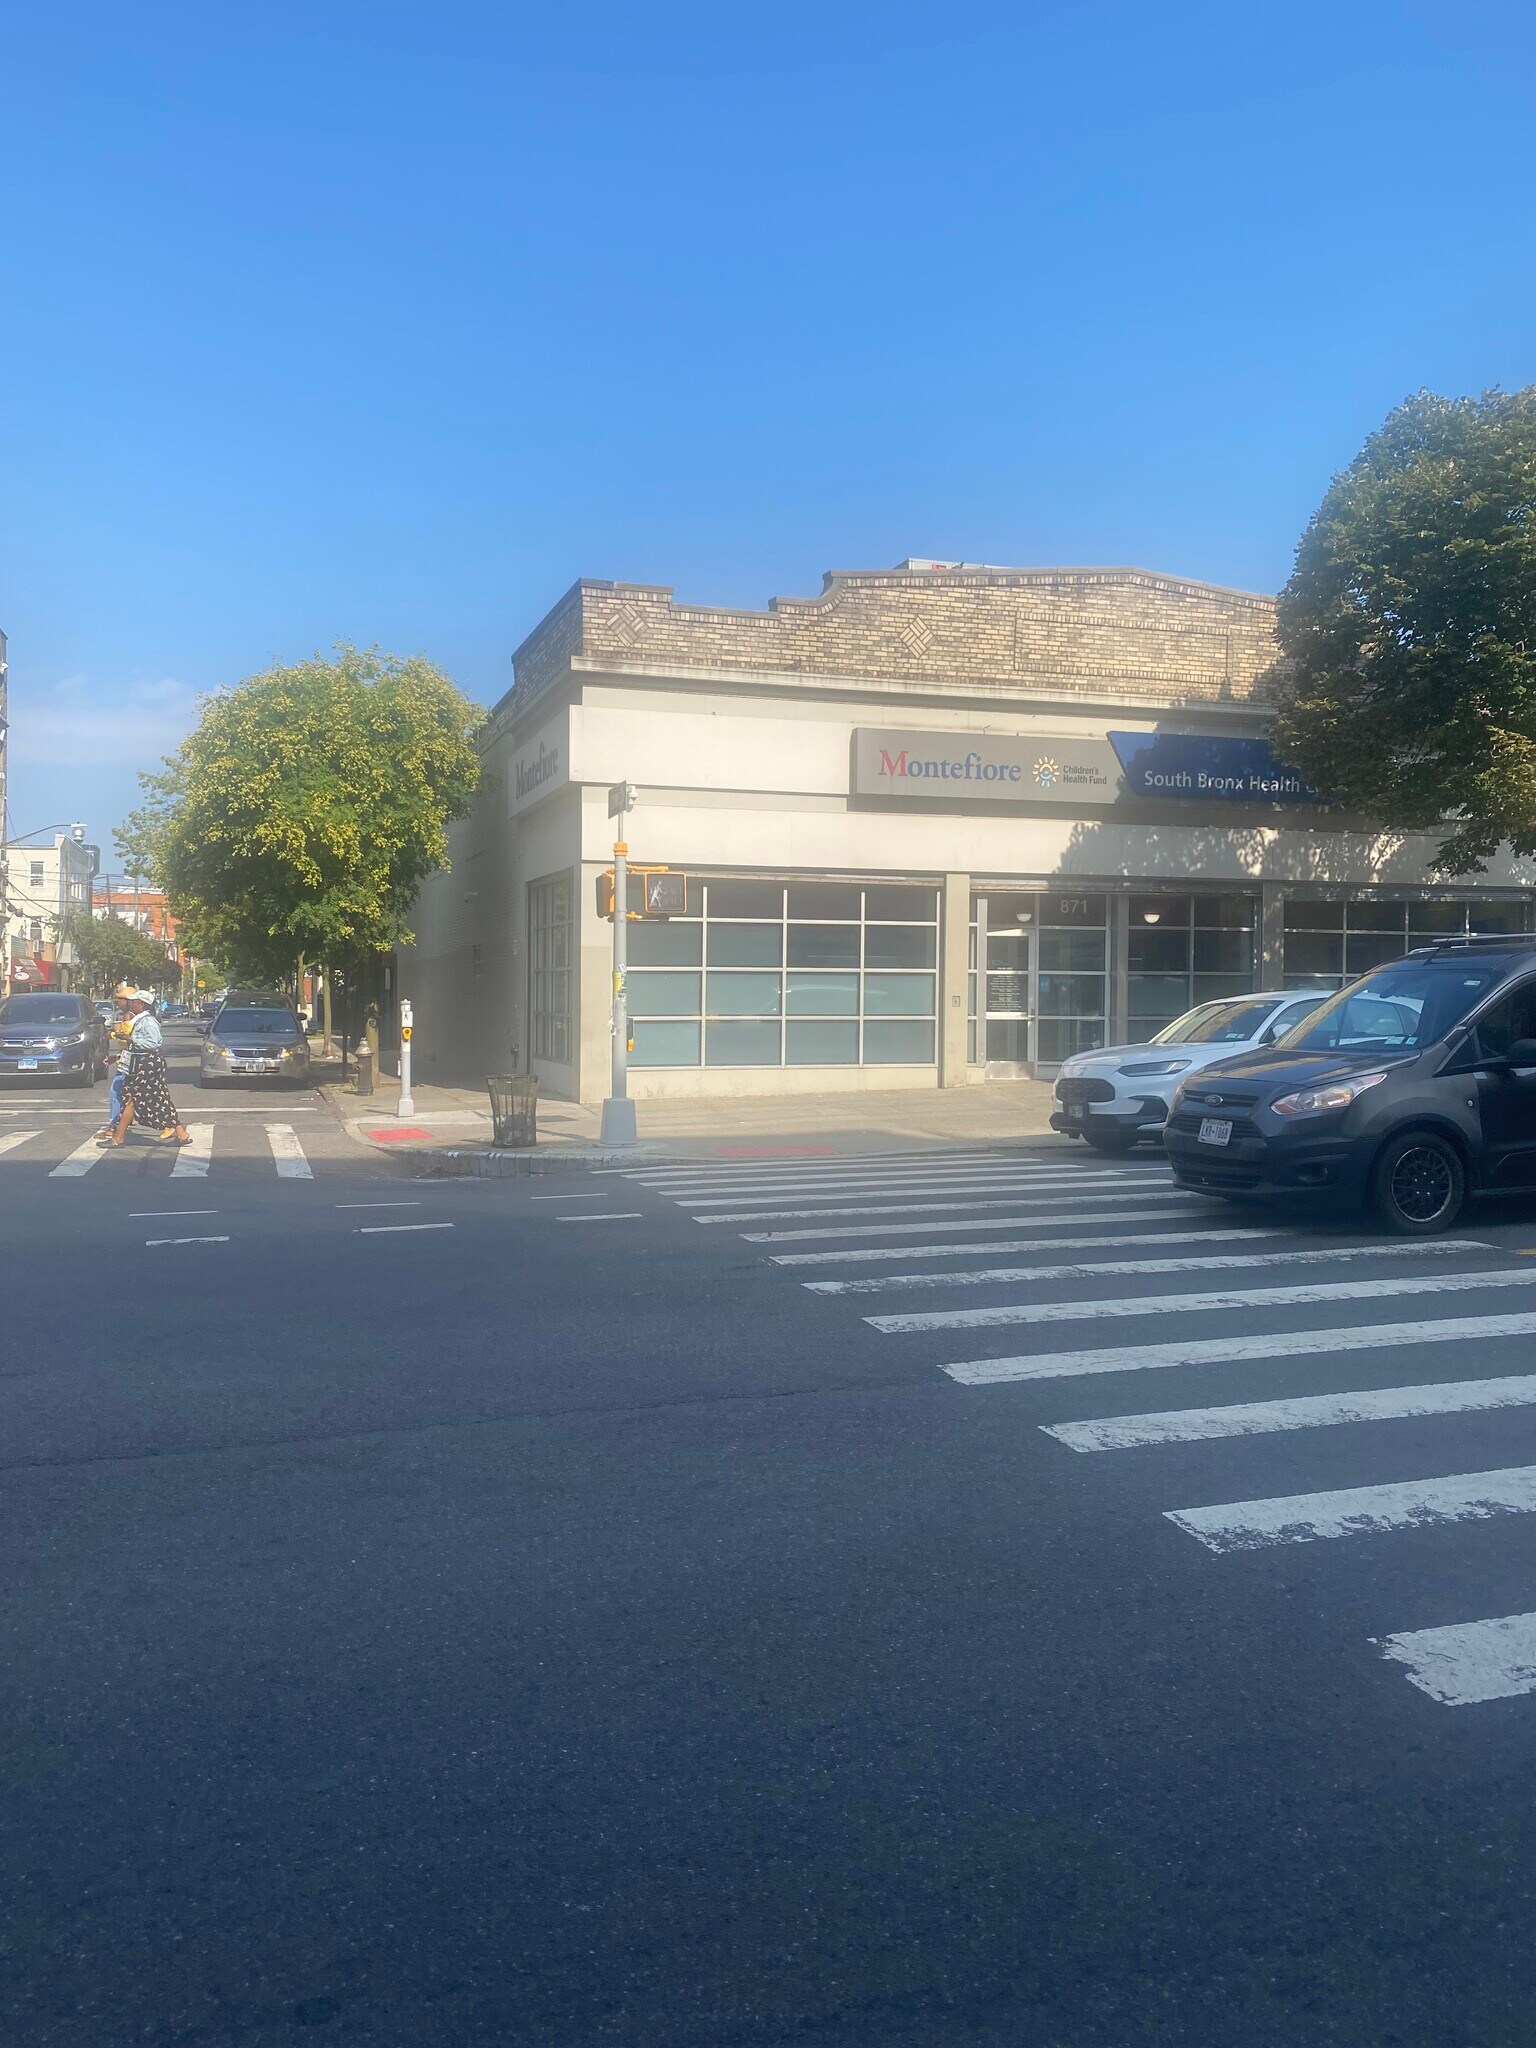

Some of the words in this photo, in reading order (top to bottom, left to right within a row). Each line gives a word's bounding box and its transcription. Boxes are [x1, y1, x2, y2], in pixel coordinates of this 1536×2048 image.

[516, 742, 559, 800] Montefiore
[878, 749, 1022, 782] Montefiore
[1063, 765, 1099, 775] Children's
[1063, 774, 1088, 784] Health
[1089, 775, 1107, 785] Fund
[1144, 770, 1192, 788] South
[1197, 772, 1244, 790] Bronx
[1249, 775, 1300, 793] Health
[1060, 899, 1087, 914] 871
